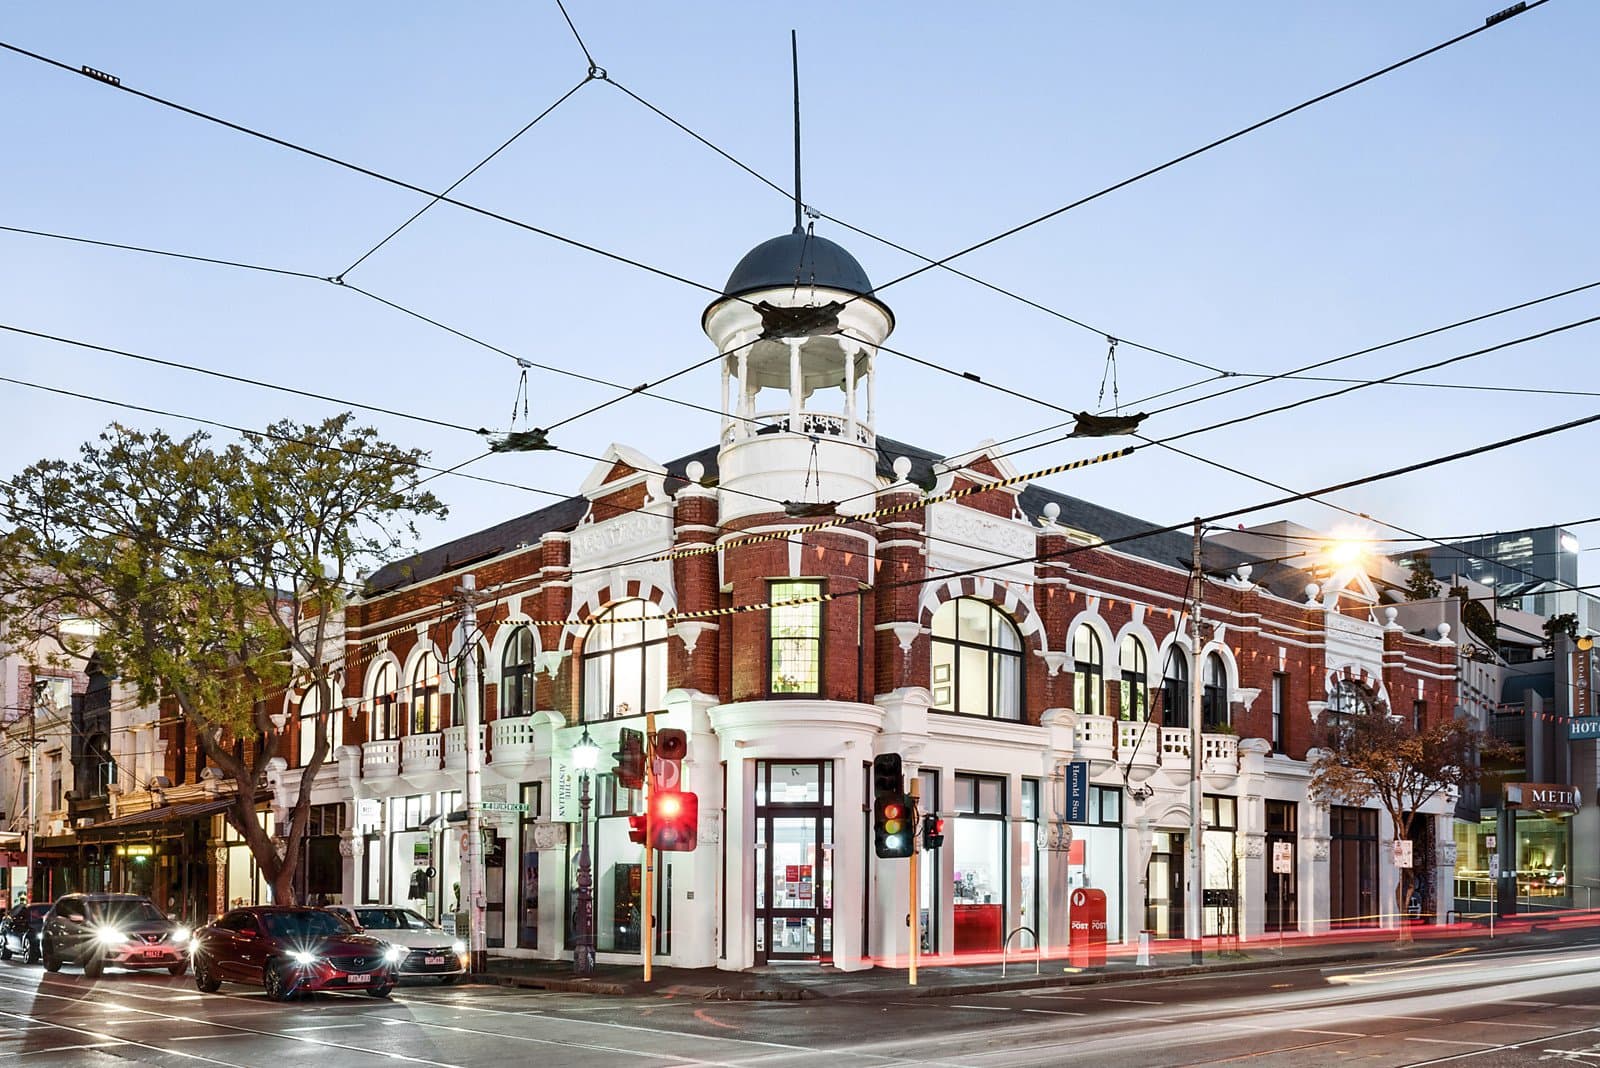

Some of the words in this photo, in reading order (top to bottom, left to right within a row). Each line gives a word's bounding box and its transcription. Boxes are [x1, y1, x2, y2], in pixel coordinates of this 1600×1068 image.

[559, 763, 567, 817] AUSTRALIAN
[1072, 765, 1080, 797] Herald
[1072, 799, 1080, 819] Sun
[1071, 922, 1089, 930] POST
[1091, 922, 1106, 930] POST
